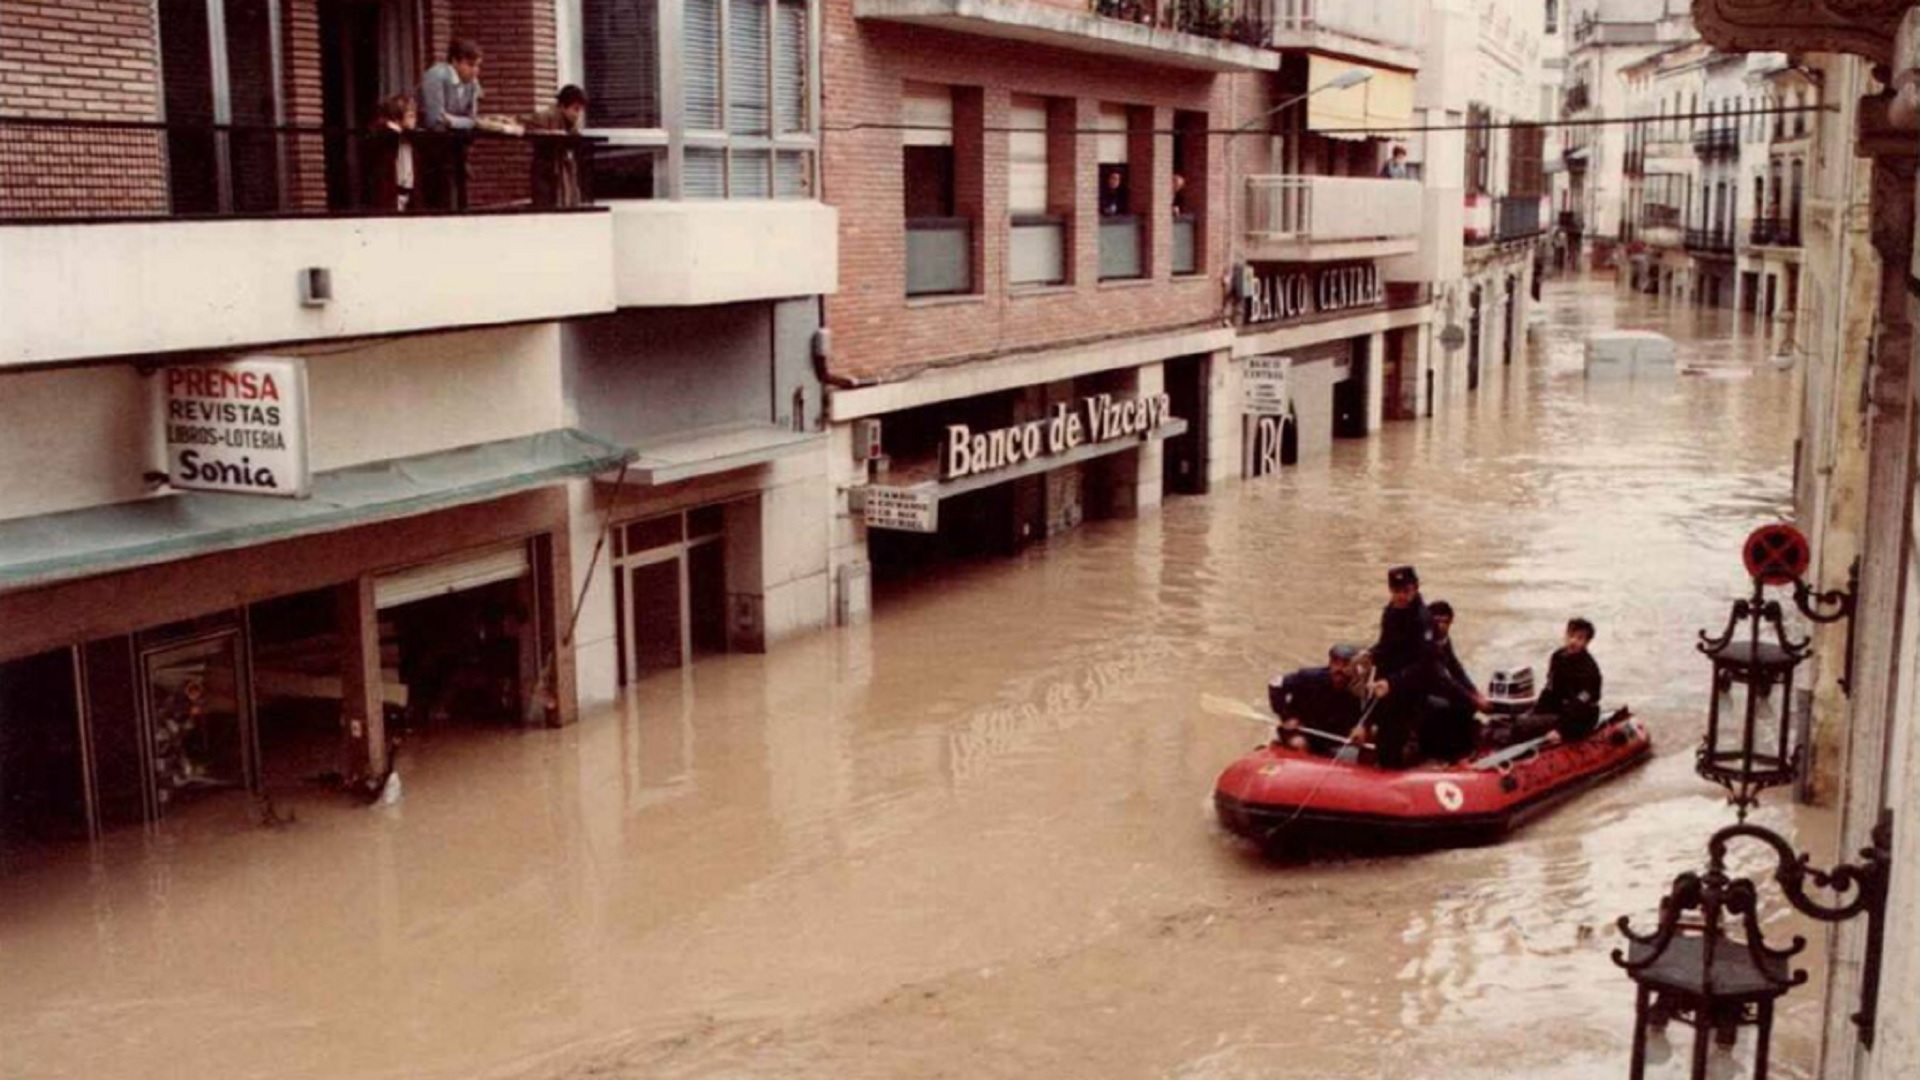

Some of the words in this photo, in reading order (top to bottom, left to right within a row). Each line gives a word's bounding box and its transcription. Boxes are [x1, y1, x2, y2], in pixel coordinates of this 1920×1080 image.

[1249, 272, 1308, 322] BANCO
[1319, 263, 1382, 311] CENTRAL
[167, 367, 280, 401] PRENSA
[168, 398, 281, 426] REVISTAS
[948, 421, 1040, 479] Banco
[1051, 402, 1082, 453] de
[1083, 392, 1171, 444] Vizcaya
[179, 449, 278, 488] Sonia
